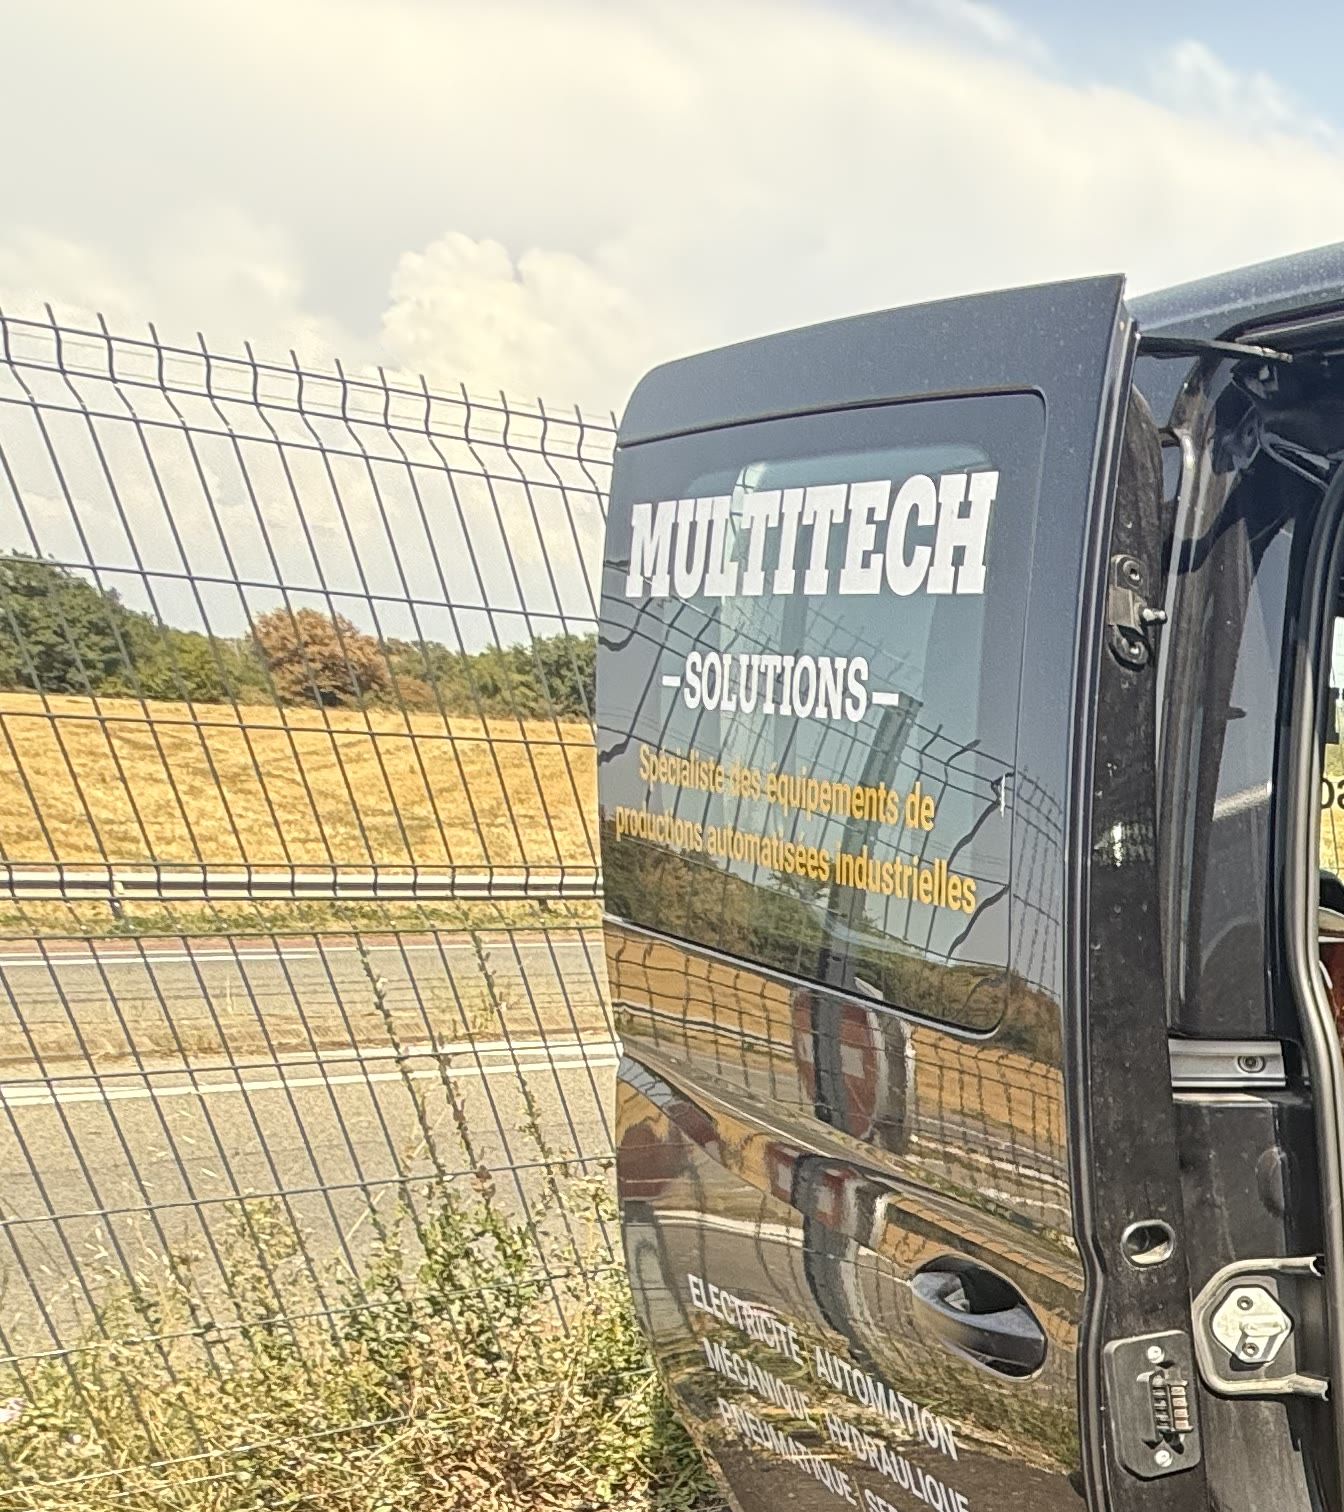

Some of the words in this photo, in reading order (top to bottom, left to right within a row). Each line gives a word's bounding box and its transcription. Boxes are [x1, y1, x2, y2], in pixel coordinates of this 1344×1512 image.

[626, 471, 999, 598] MULTITECH
[639, 743, 725, 794] Spécialiste
[730, 760, 762, 801] des
[765, 761, 899, 825] équipements
[905, 780, 935, 832] de
[615, 800, 703, 852] productions
[707, 822, 830, 882] automatisées
[835, 840, 977, 914] industrielles
[703, 1336, 818, 1429] MÉCANIQUE
[815, 1345, 959, 1462] AUTOMATION
[717, 1396, 859, 1507] PNEUMATIQUE
